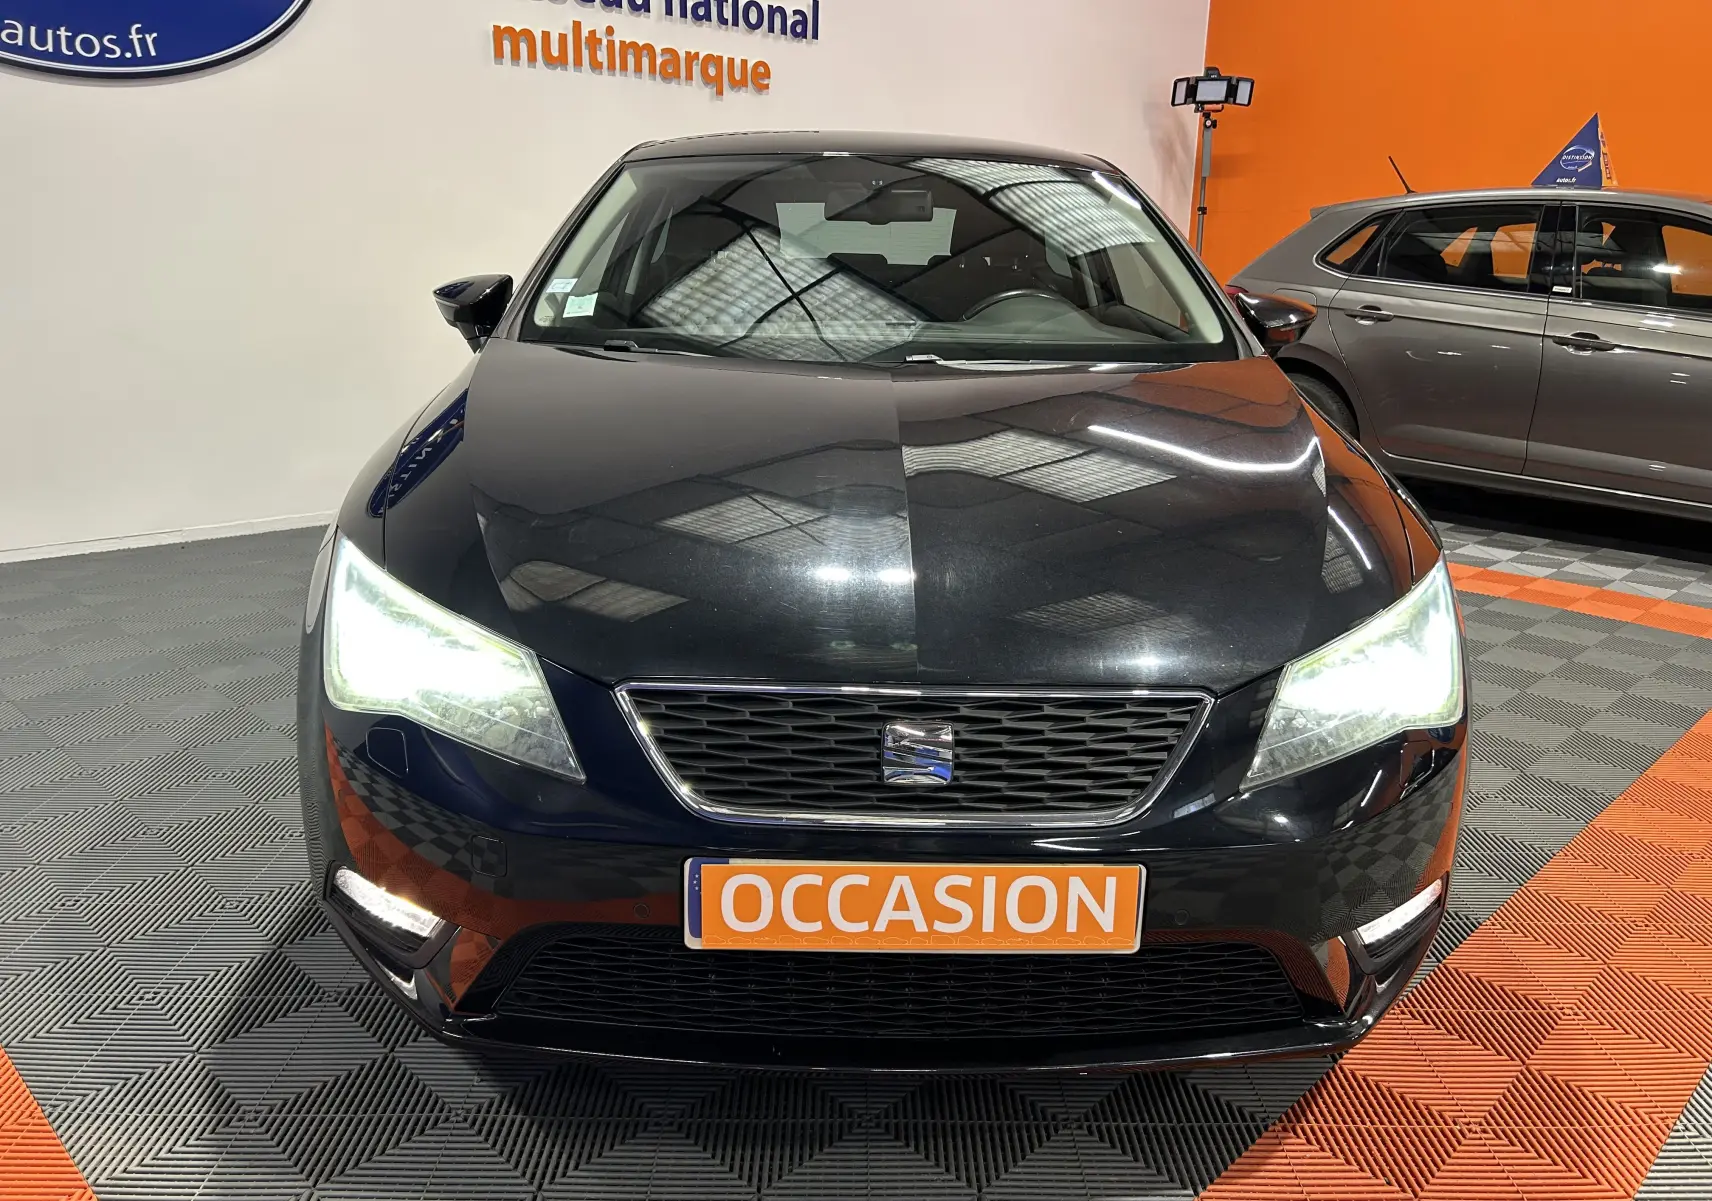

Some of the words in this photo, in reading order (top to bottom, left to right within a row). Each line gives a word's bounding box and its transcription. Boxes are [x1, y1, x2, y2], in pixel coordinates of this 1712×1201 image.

[0, 19, 157, 58] autos.fr
[665, 0, 819, 40] national
[493, 20, 771, 97] multimarque
[720, 874, 1117, 933] OCCASION
